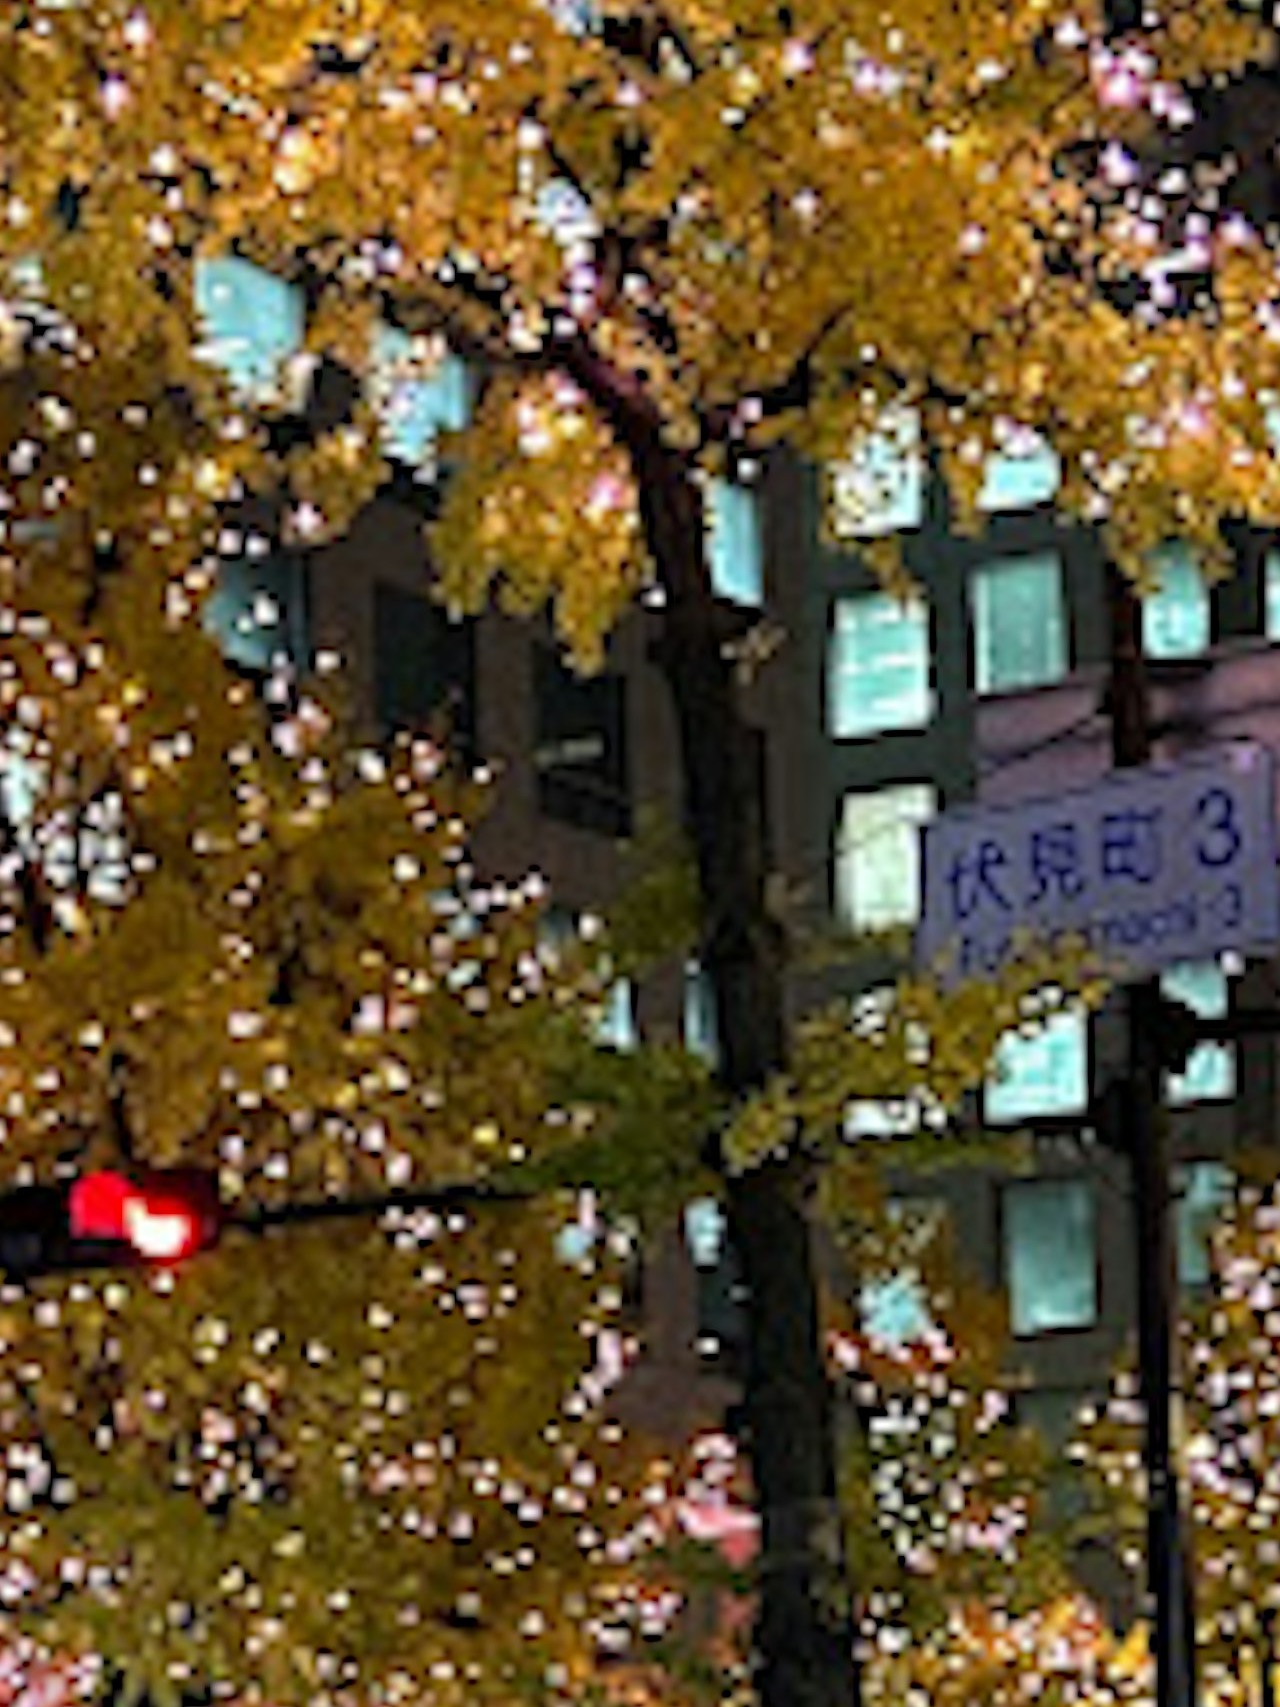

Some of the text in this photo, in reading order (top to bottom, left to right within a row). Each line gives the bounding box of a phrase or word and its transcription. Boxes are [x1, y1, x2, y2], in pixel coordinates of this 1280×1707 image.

[946, 787, 1241, 918] 伏見町 3
